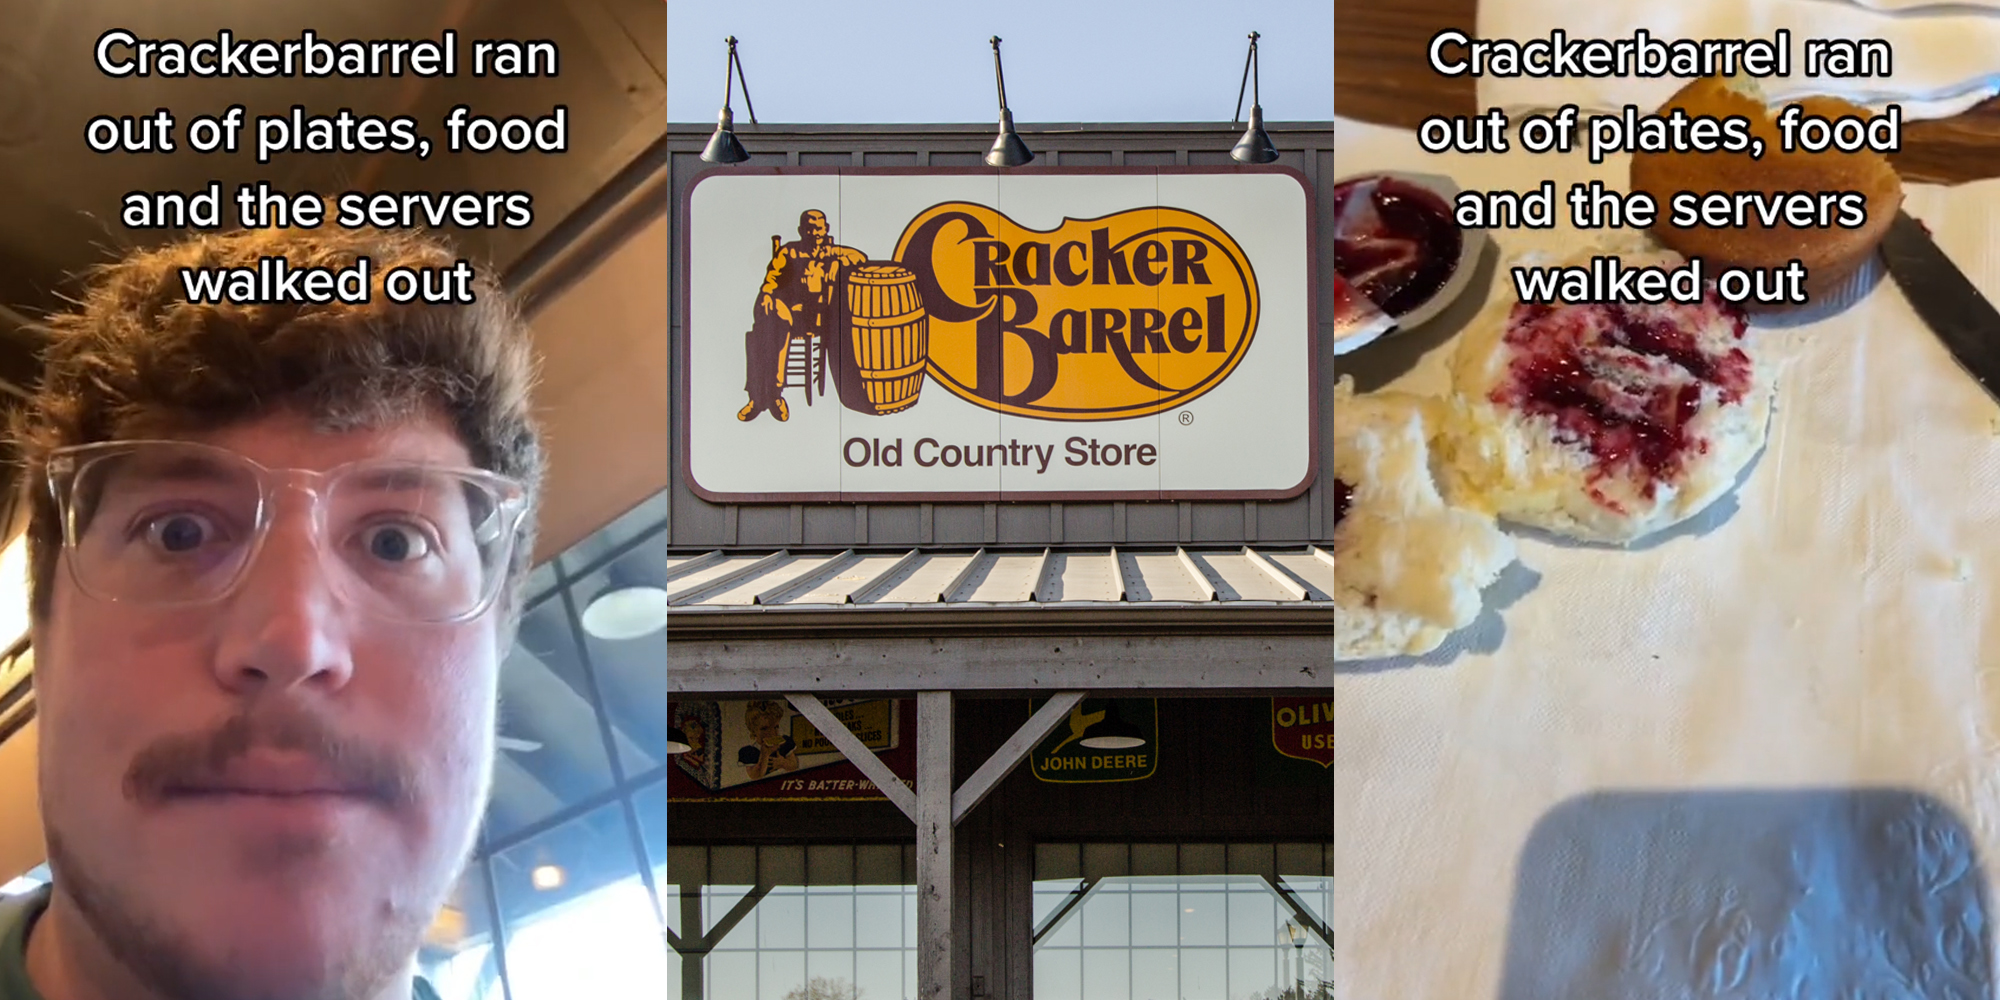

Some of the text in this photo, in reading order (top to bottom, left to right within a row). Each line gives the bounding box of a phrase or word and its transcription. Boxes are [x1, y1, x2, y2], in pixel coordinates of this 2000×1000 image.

[843, 436, 1158, 474] Old Country Store
[1040, 754, 1148, 771] JOHN DEERE
[781, 779, 804, 790] IT'S
